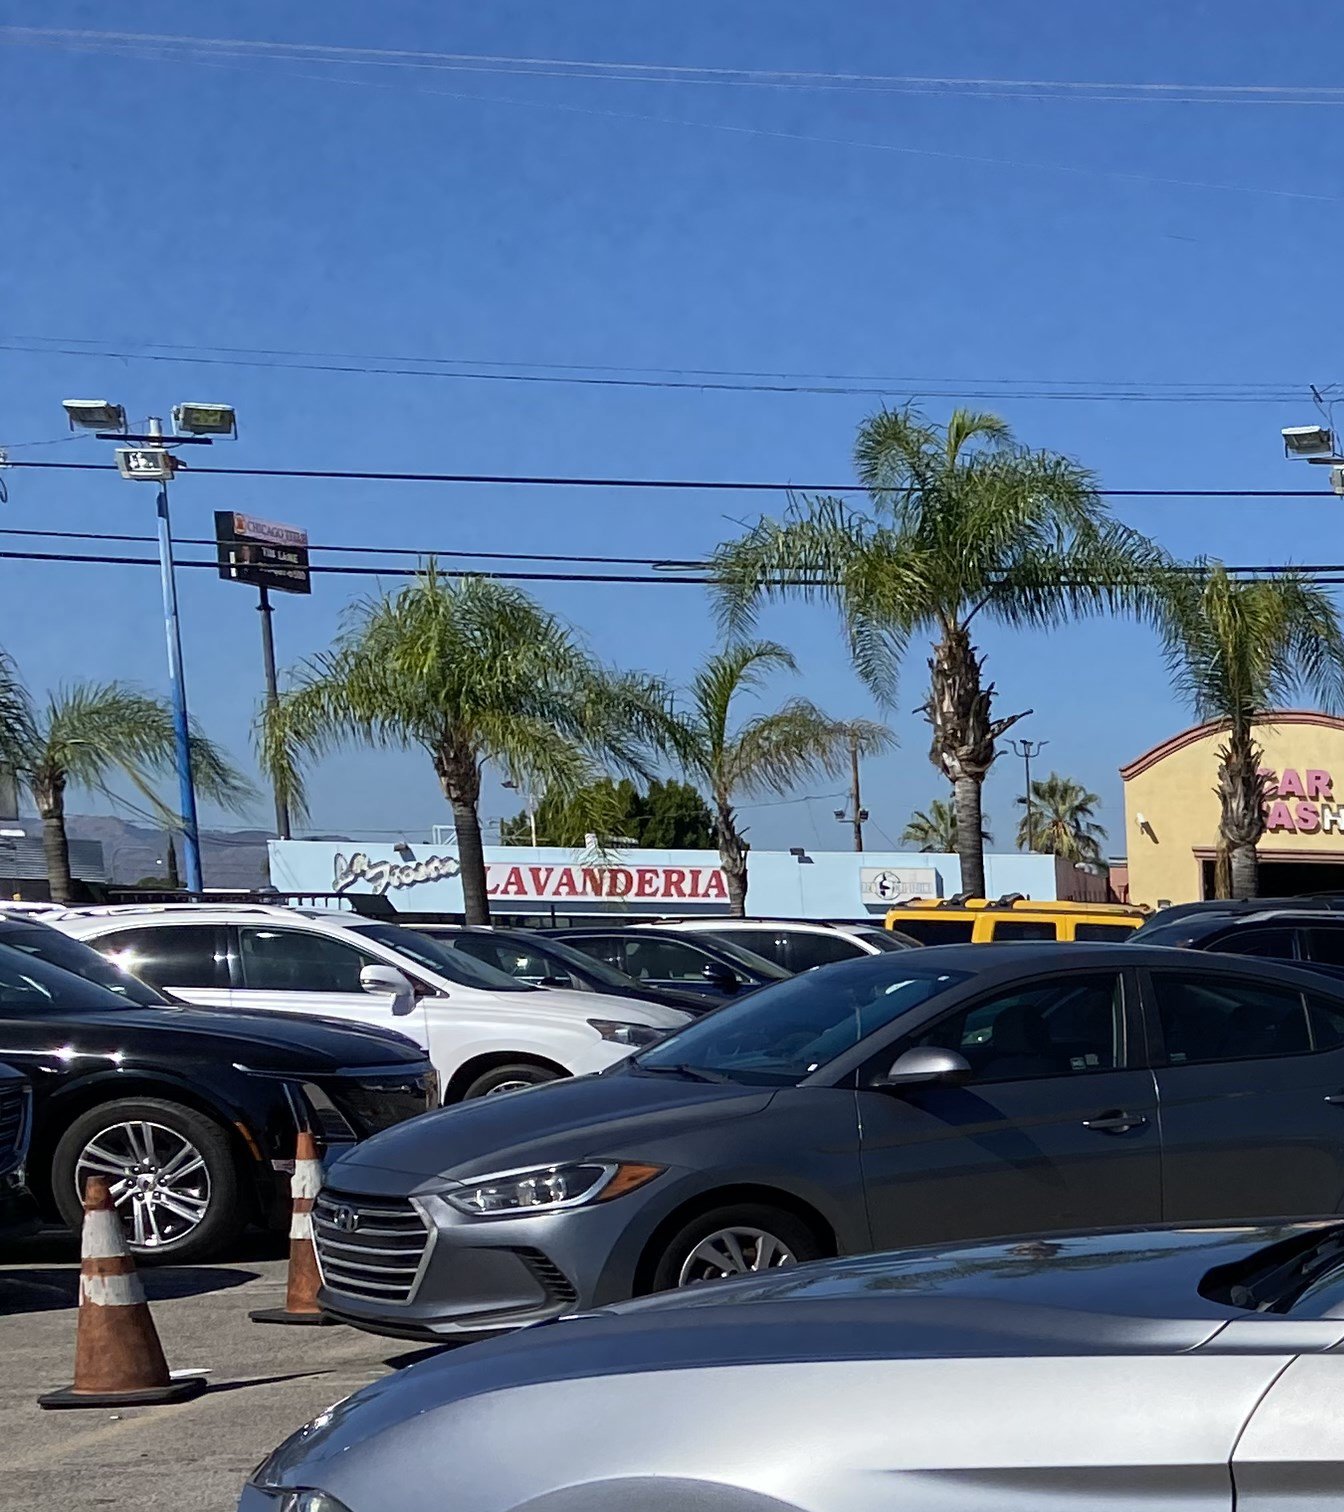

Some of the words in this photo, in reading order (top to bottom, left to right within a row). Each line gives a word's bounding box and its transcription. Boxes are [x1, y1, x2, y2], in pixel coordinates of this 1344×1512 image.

[247, 521, 284, 538] CHICAGO
[1256, 768, 1332, 798] CAR
[484, 866, 729, 898] LAVANDERIA
